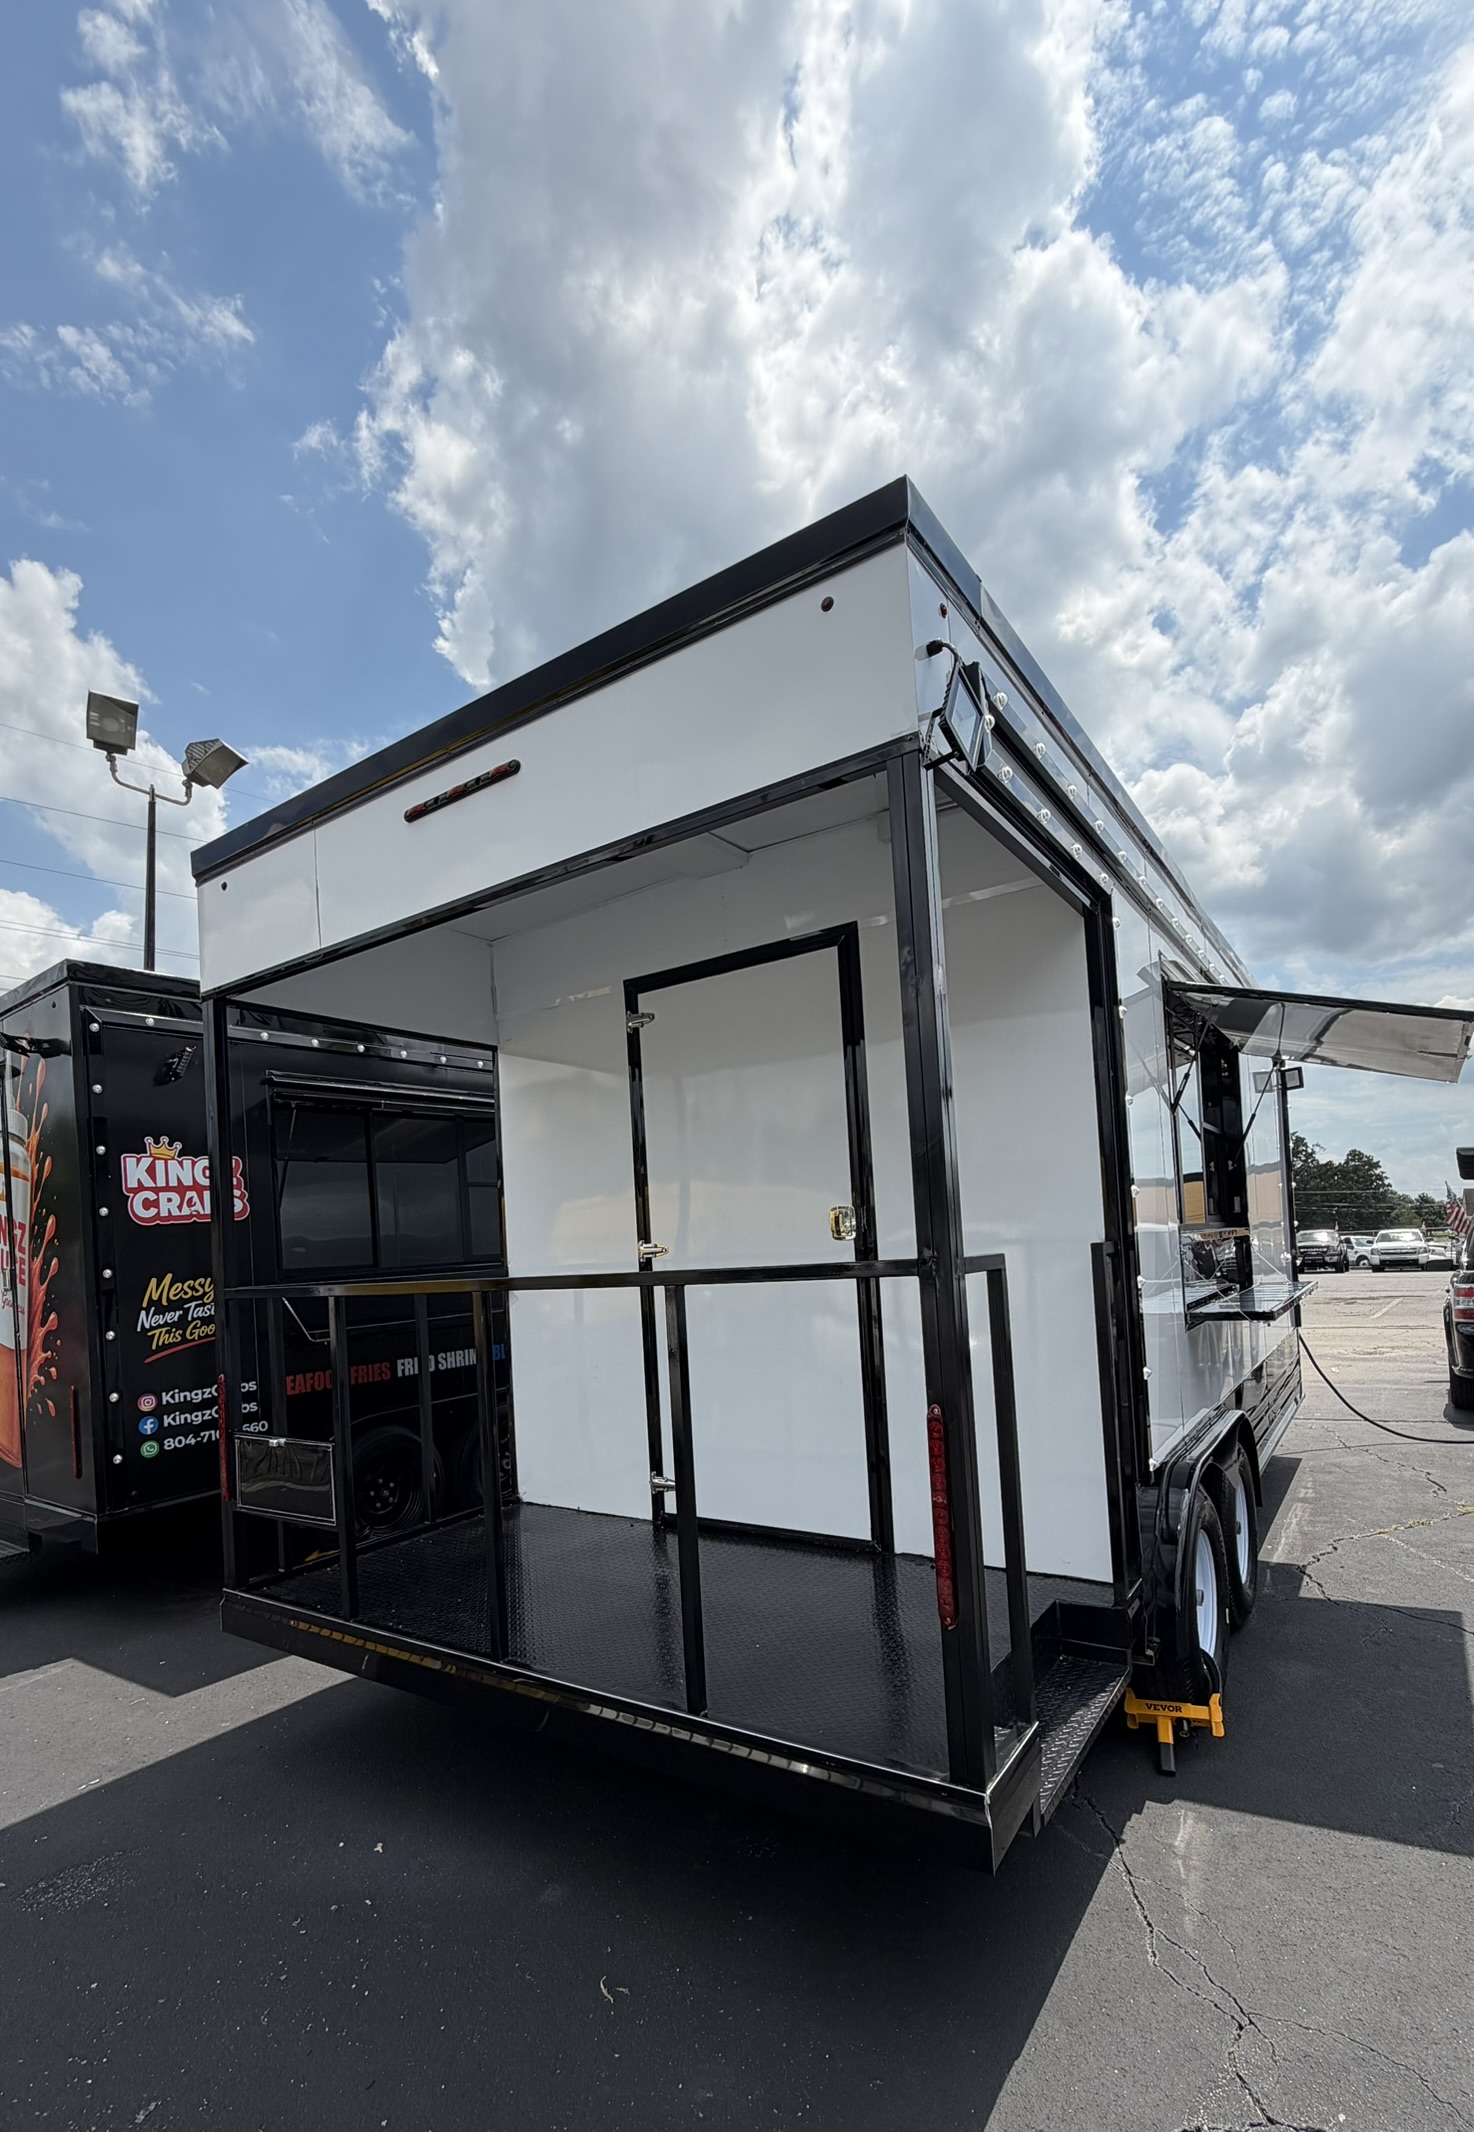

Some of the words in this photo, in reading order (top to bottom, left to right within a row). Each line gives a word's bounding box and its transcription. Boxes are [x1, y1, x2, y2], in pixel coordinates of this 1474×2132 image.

[125, 1157, 236, 1188] KING
[142, 1273, 214, 1308] Messy
[136, 1306, 183, 1332] Never
[147, 1327, 183, 1350] This
[185, 1319, 216, 1341] Goo
[350, 1362, 391, 1385] FRIES
[397, 1356, 436, 1377] FRID
[1145, 1702, 1183, 1713] VEVOR
